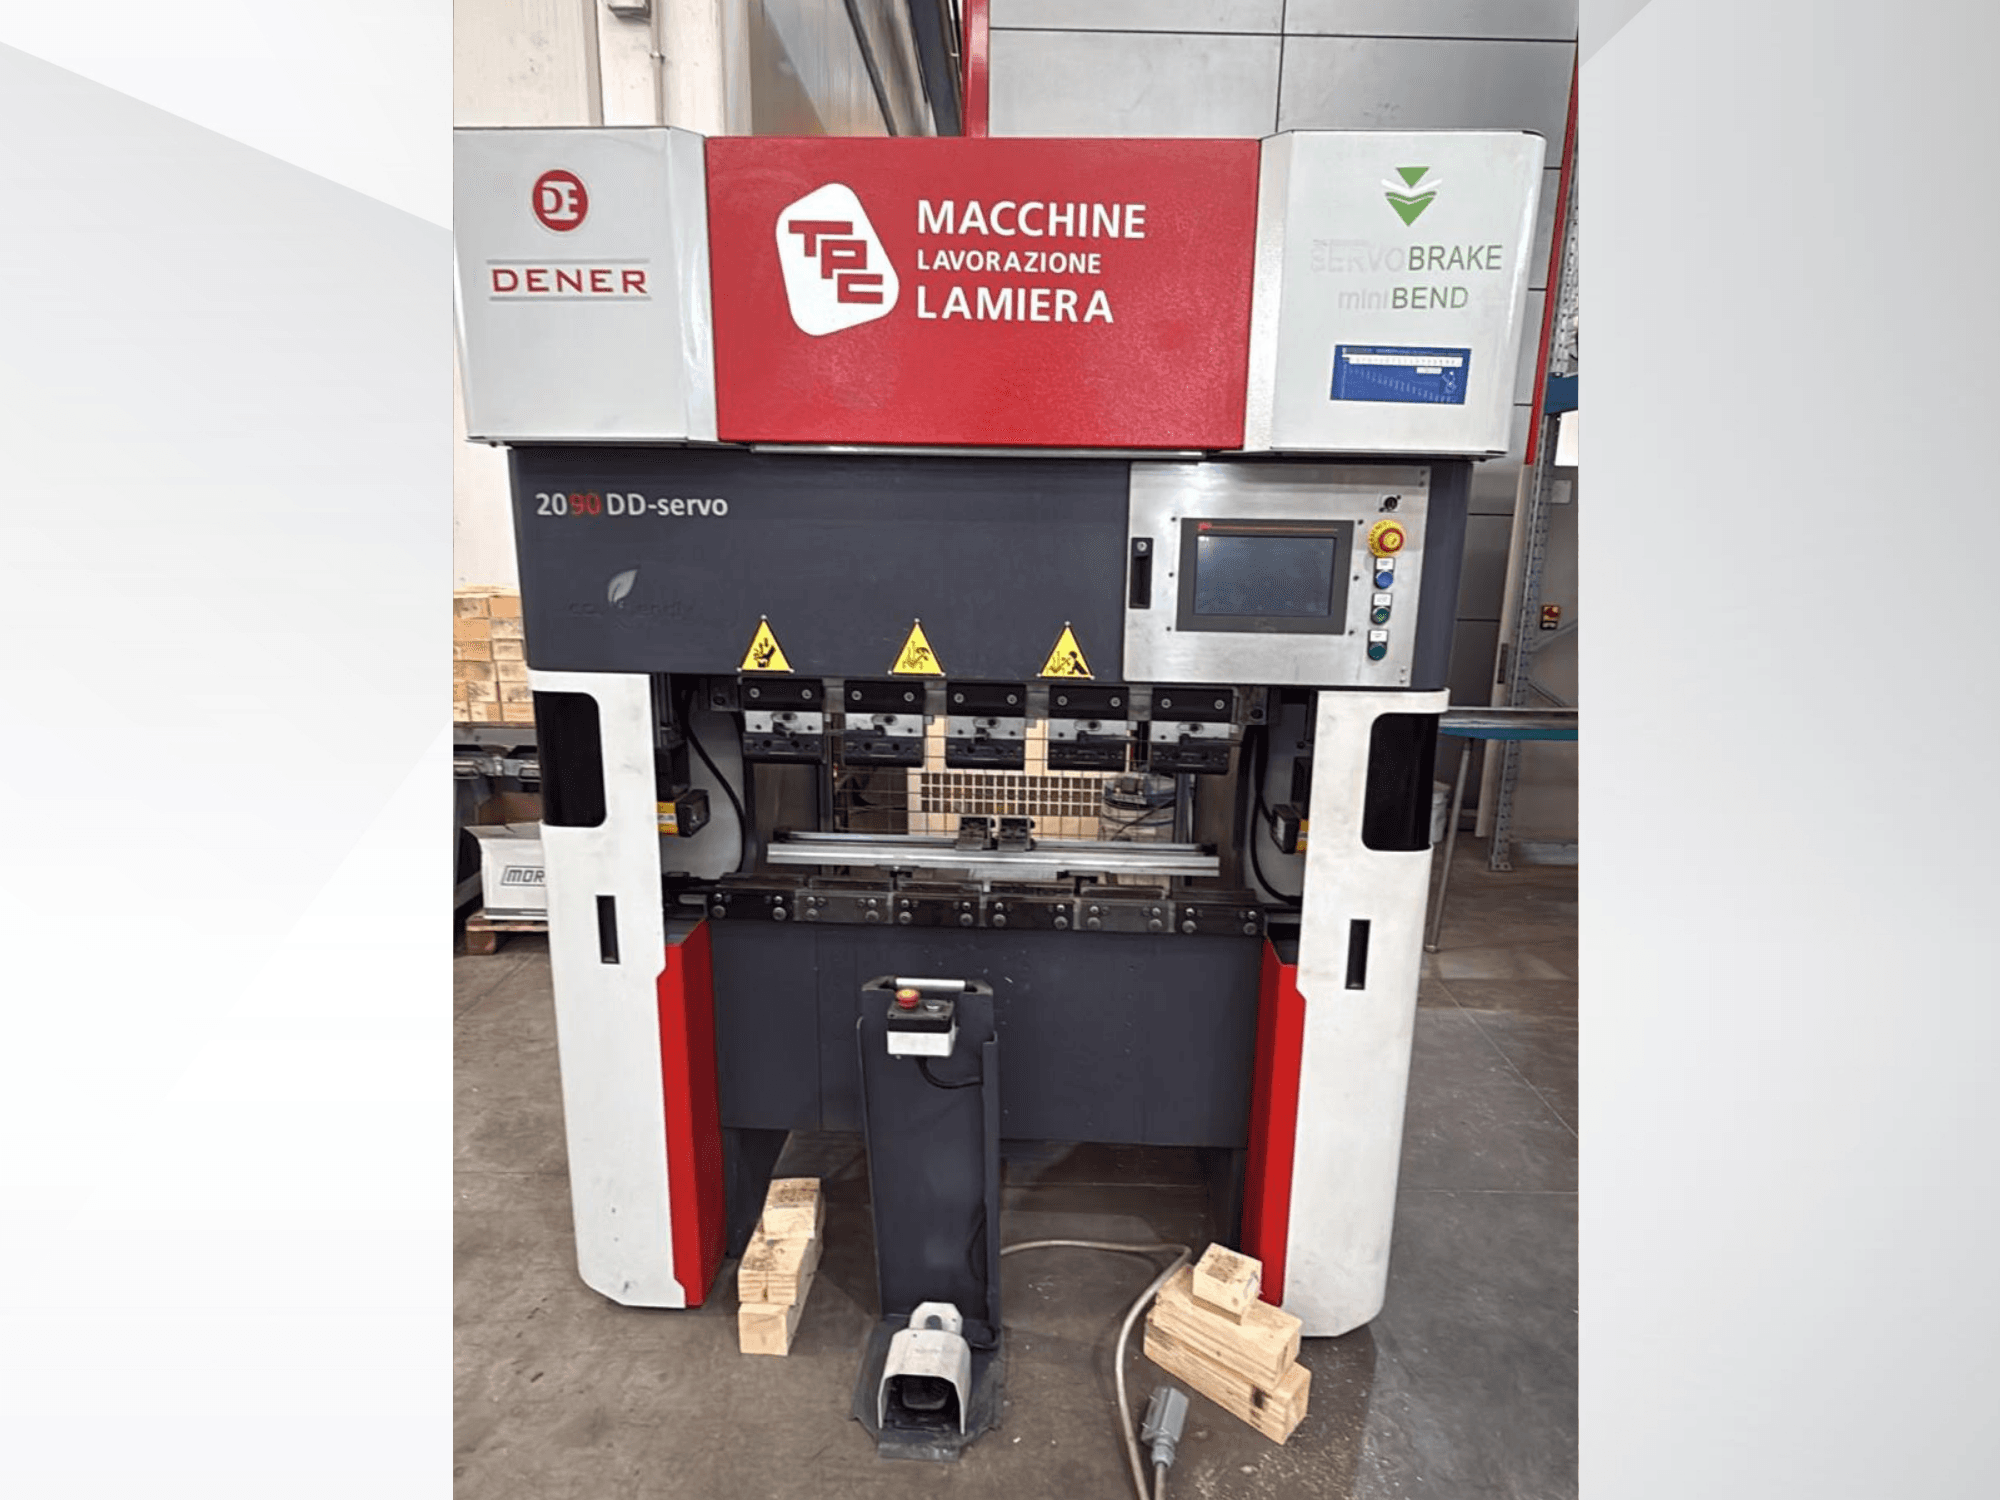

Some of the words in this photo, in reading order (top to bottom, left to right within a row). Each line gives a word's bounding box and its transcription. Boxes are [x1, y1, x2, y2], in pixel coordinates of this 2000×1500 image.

[917, 199, 1147, 239] MACCHINE
[788, 220, 883, 304] TPC
[917, 249, 1102, 274] LAVORAZIONE
[491, 268, 648, 294] DENER
[917, 285, 1114, 323] LAMIERA
[535, 492, 602, 516] 2090
[606, 492, 729, 516] DD-servo
